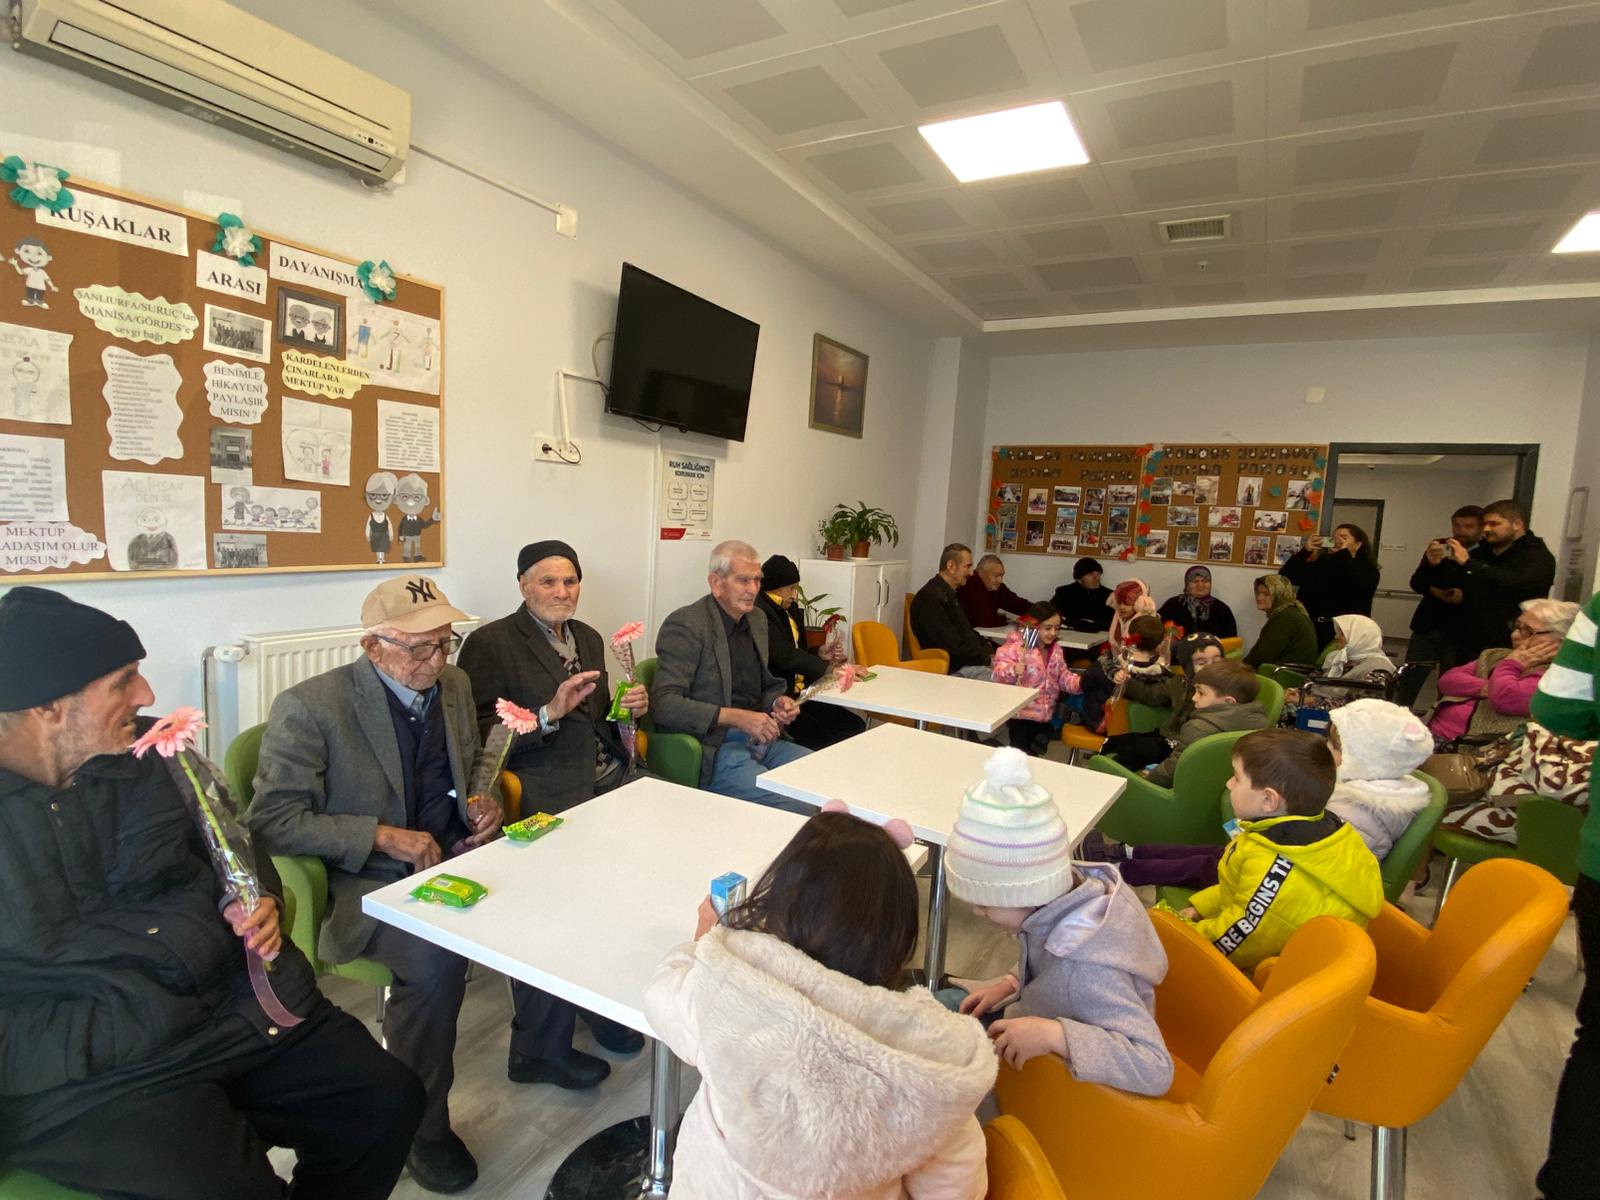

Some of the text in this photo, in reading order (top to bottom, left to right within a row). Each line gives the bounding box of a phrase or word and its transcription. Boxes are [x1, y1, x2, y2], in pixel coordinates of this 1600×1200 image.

[279, 255, 364, 290] DAYANIŞMA
[208, 271, 261, 295] ARASI
[214, 365, 261, 380] BENİMLE
[286, 353, 370, 379] KARDELENLERDEN
[285, 376, 345, 395] MEKTUP VAR
[6, 527, 65, 537] MEKTUP
[62, 541, 99, 551] OLUR
[5, 555, 58, 565] MUSUN
[1237, 877, 1280, 935] BEGINS
